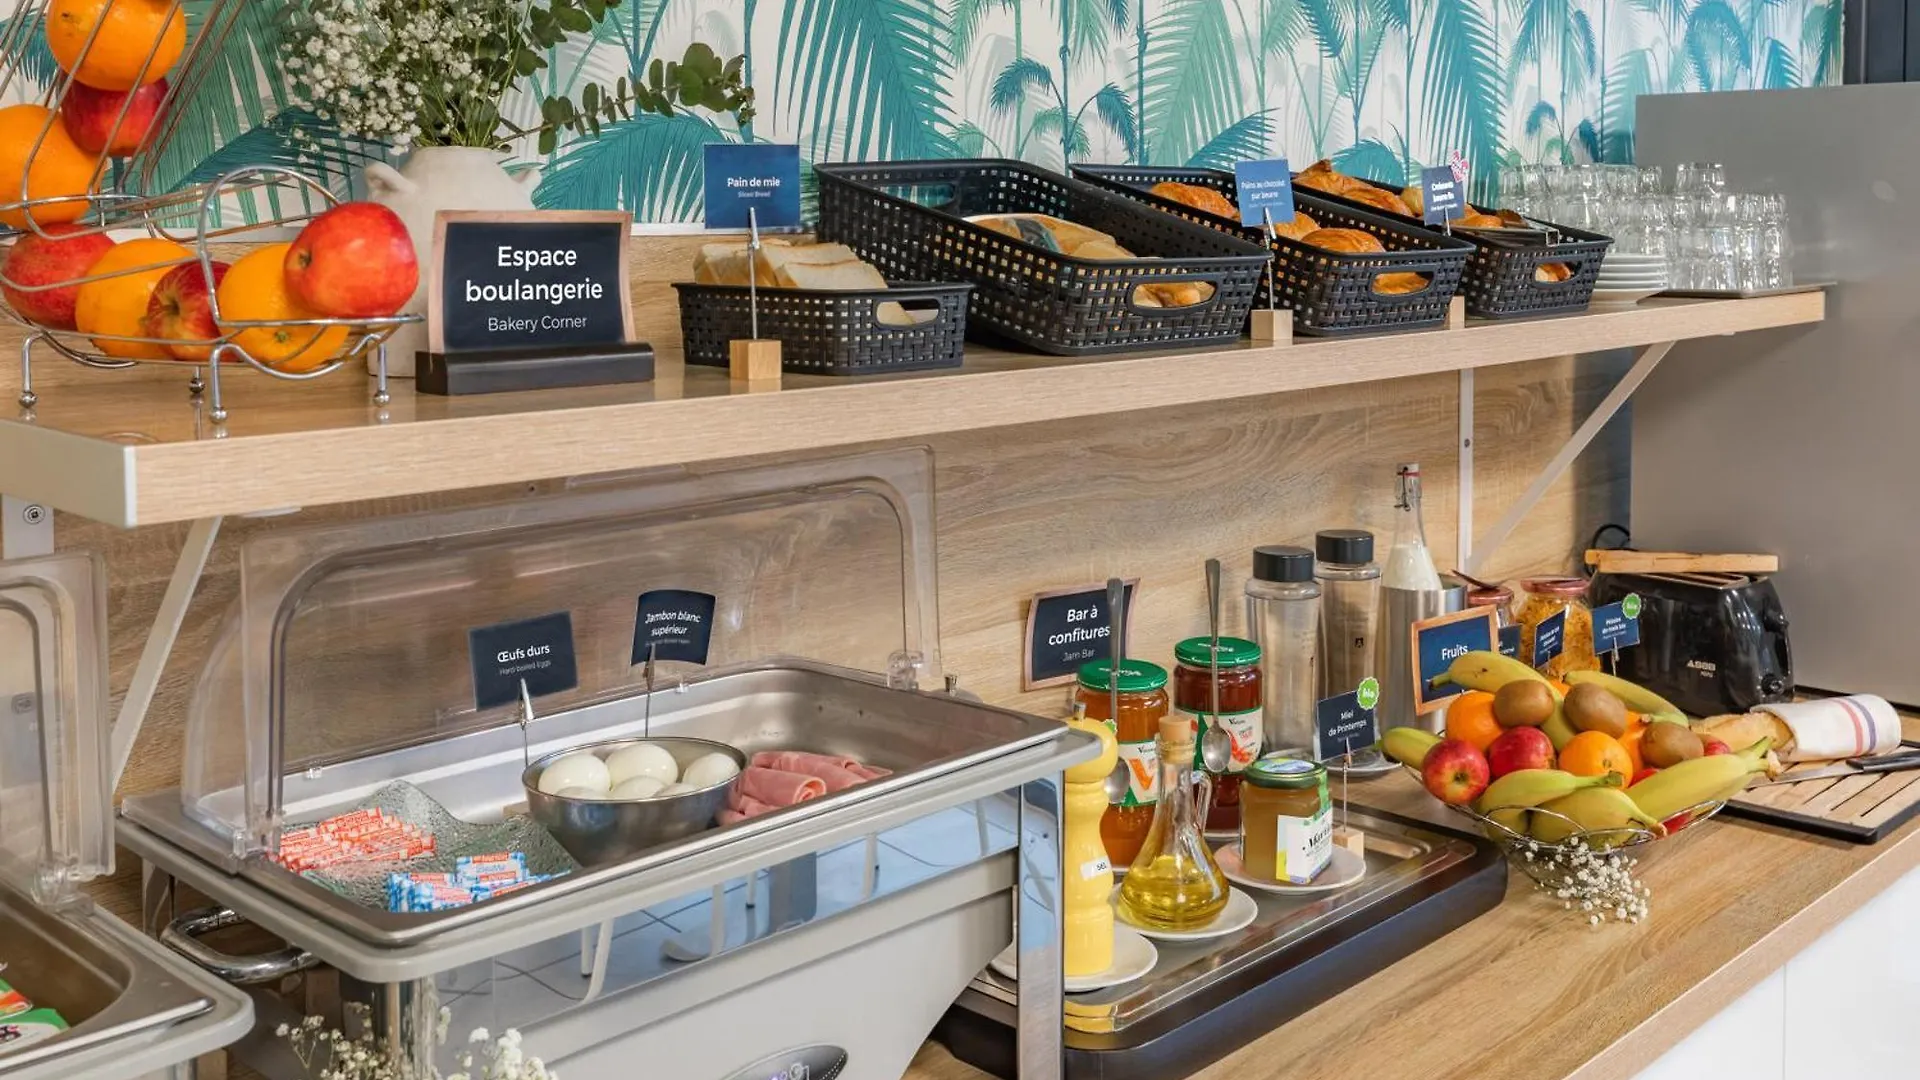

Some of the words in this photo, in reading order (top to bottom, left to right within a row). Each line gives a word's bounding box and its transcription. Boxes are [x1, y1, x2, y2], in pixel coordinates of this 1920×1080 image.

[727, 177, 748, 188] Pain
[749, 177, 761, 187] de
[763, 176, 781, 187] mie
[497, 245, 577, 271] Espace
[465, 279, 603, 304] boulangerie
[487, 317, 538, 333] Bakery
[541, 315, 588, 330] Corner
[645, 610, 677, 624] Jambon
[677, 610, 701, 623] blanc
[1067, 608, 1089, 623] Bar
[1090, 604, 1098, 619] à
[651, 624, 688, 637] supérieur
[1048, 625, 1111, 646] confitures
[497, 647, 526, 663] Œufs
[526, 644, 551, 657] durs
[1081, 648, 1096, 659] Bar
[1441, 644, 1468, 661] Fruits
[1340, 709, 1354, 720] Miel
[1328, 727, 1337, 737] de
[1336, 719, 1367, 734] Printemps
